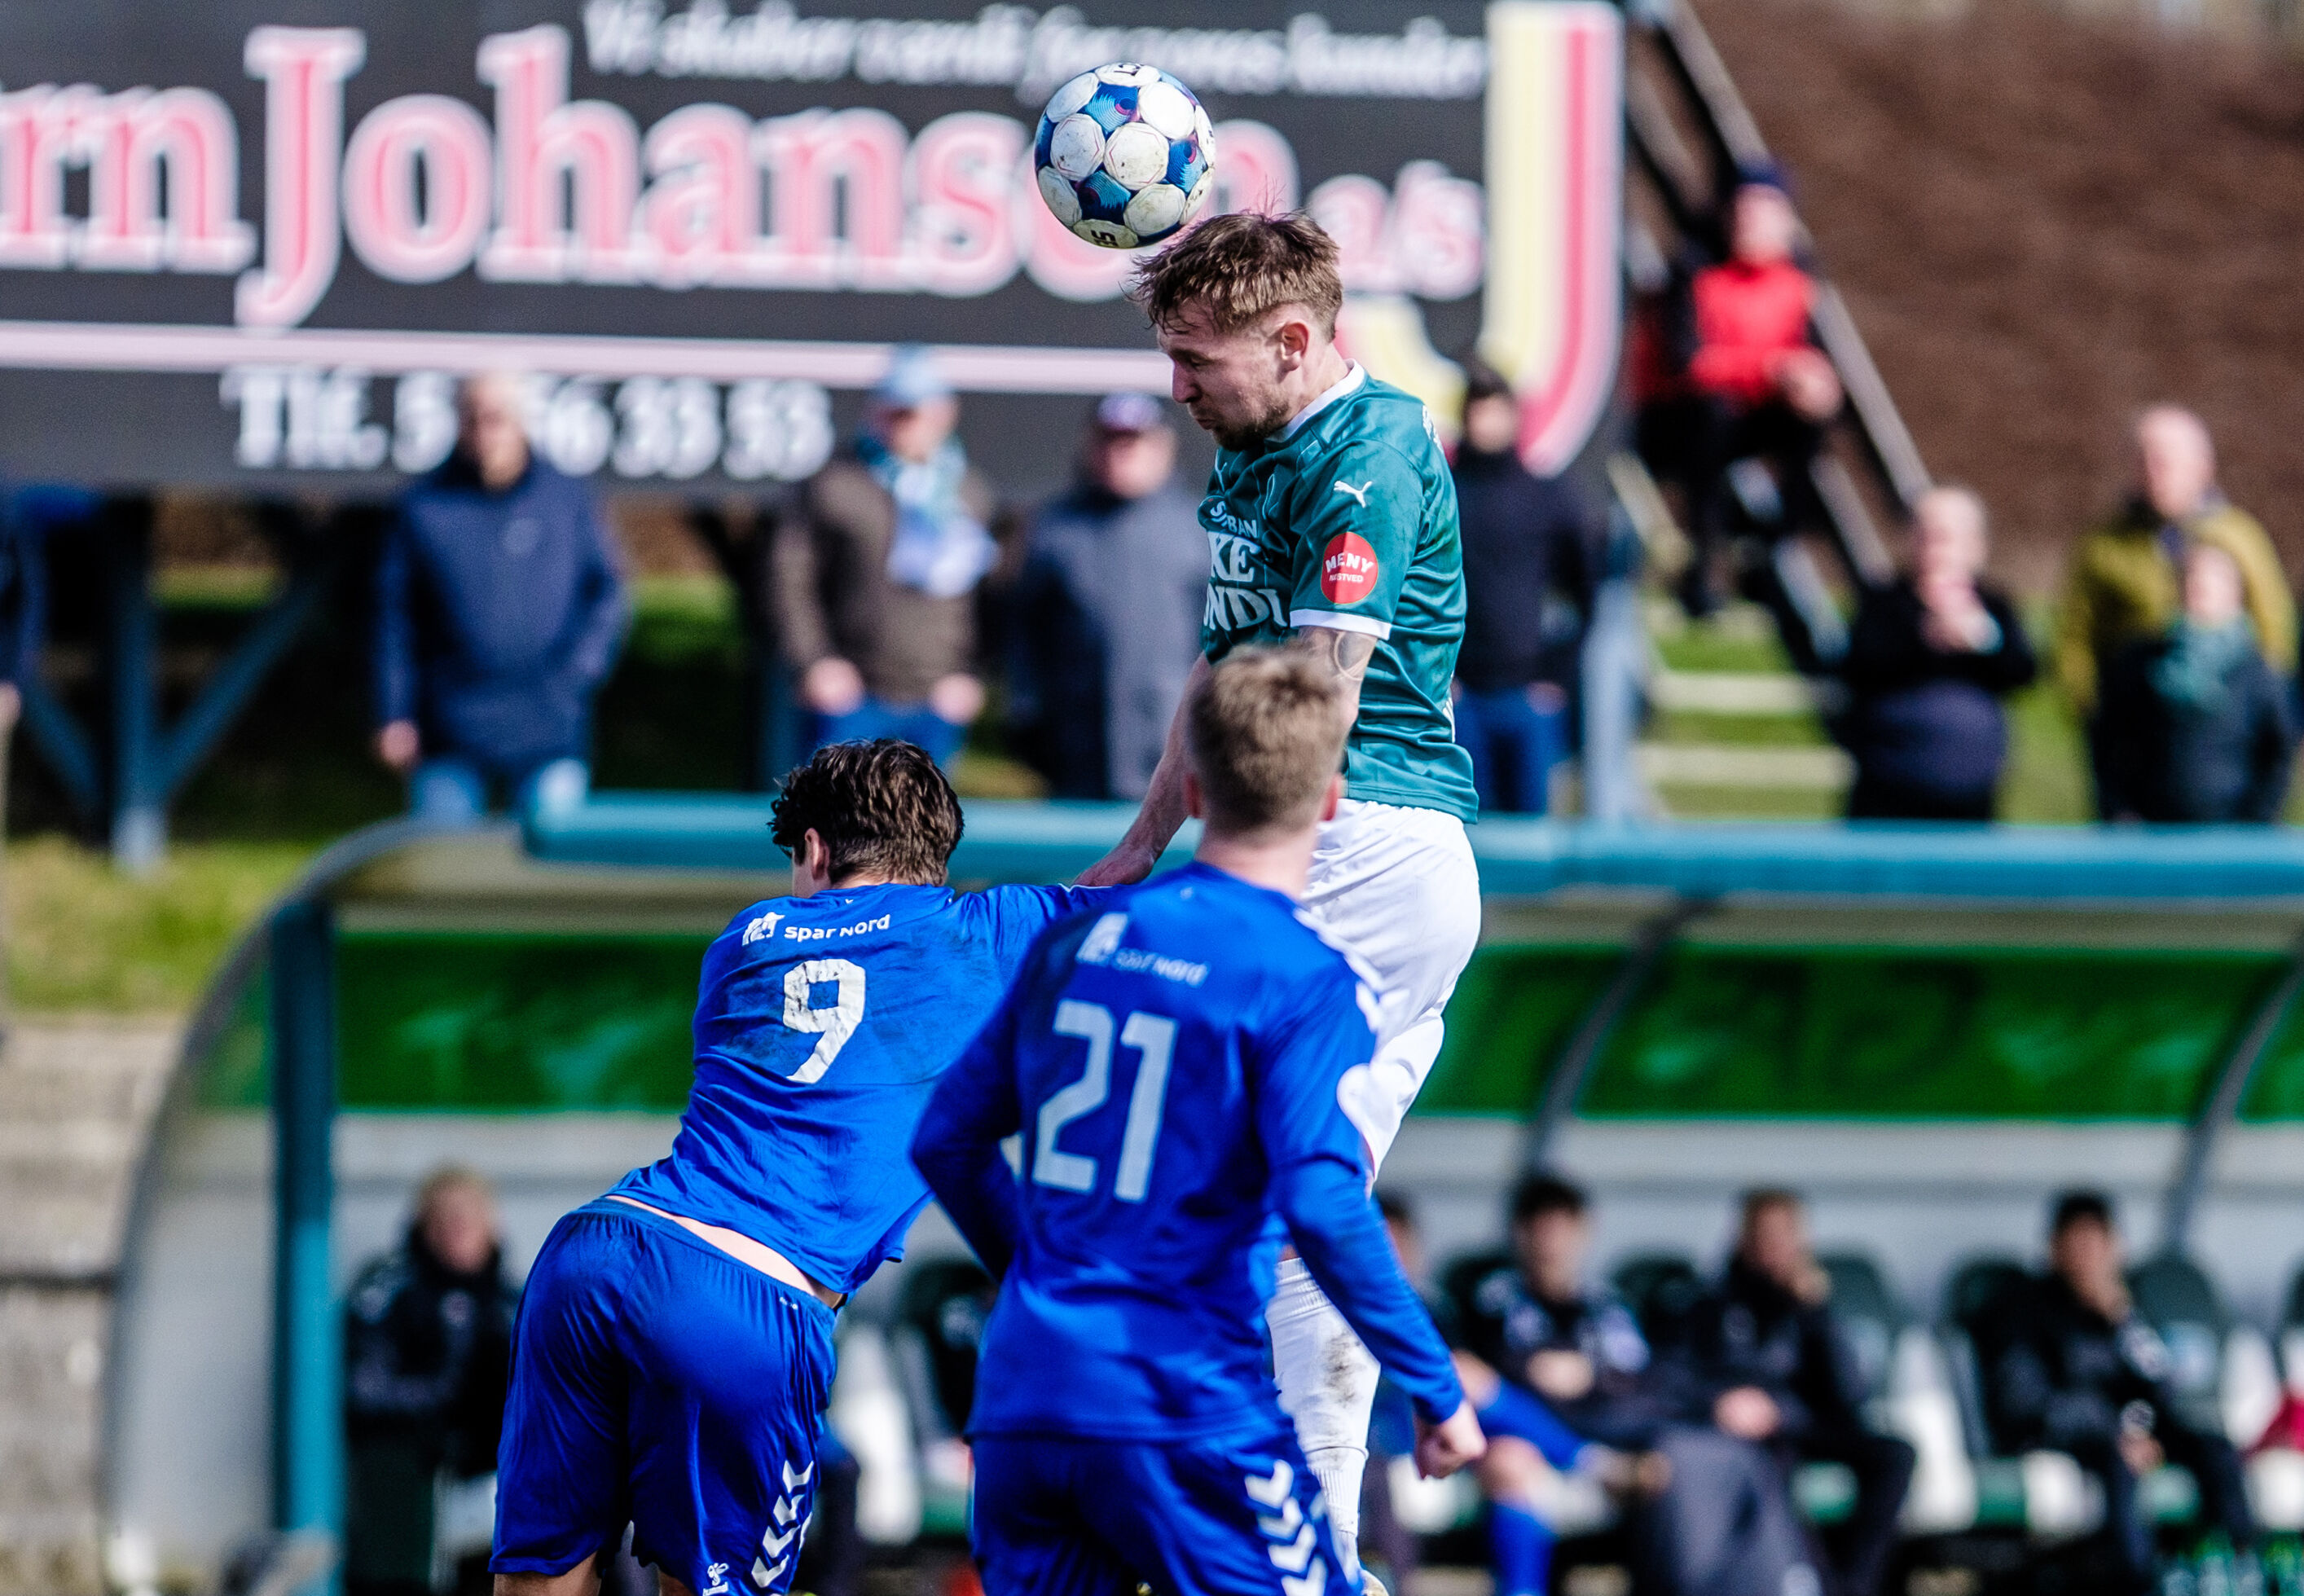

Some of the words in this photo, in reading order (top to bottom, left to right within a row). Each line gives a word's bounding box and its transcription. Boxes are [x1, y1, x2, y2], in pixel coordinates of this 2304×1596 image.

[1325, 552, 1374, 573] MENY
[782, 958, 866, 1084] 9
[1031, 999, 1179, 1202] 21
